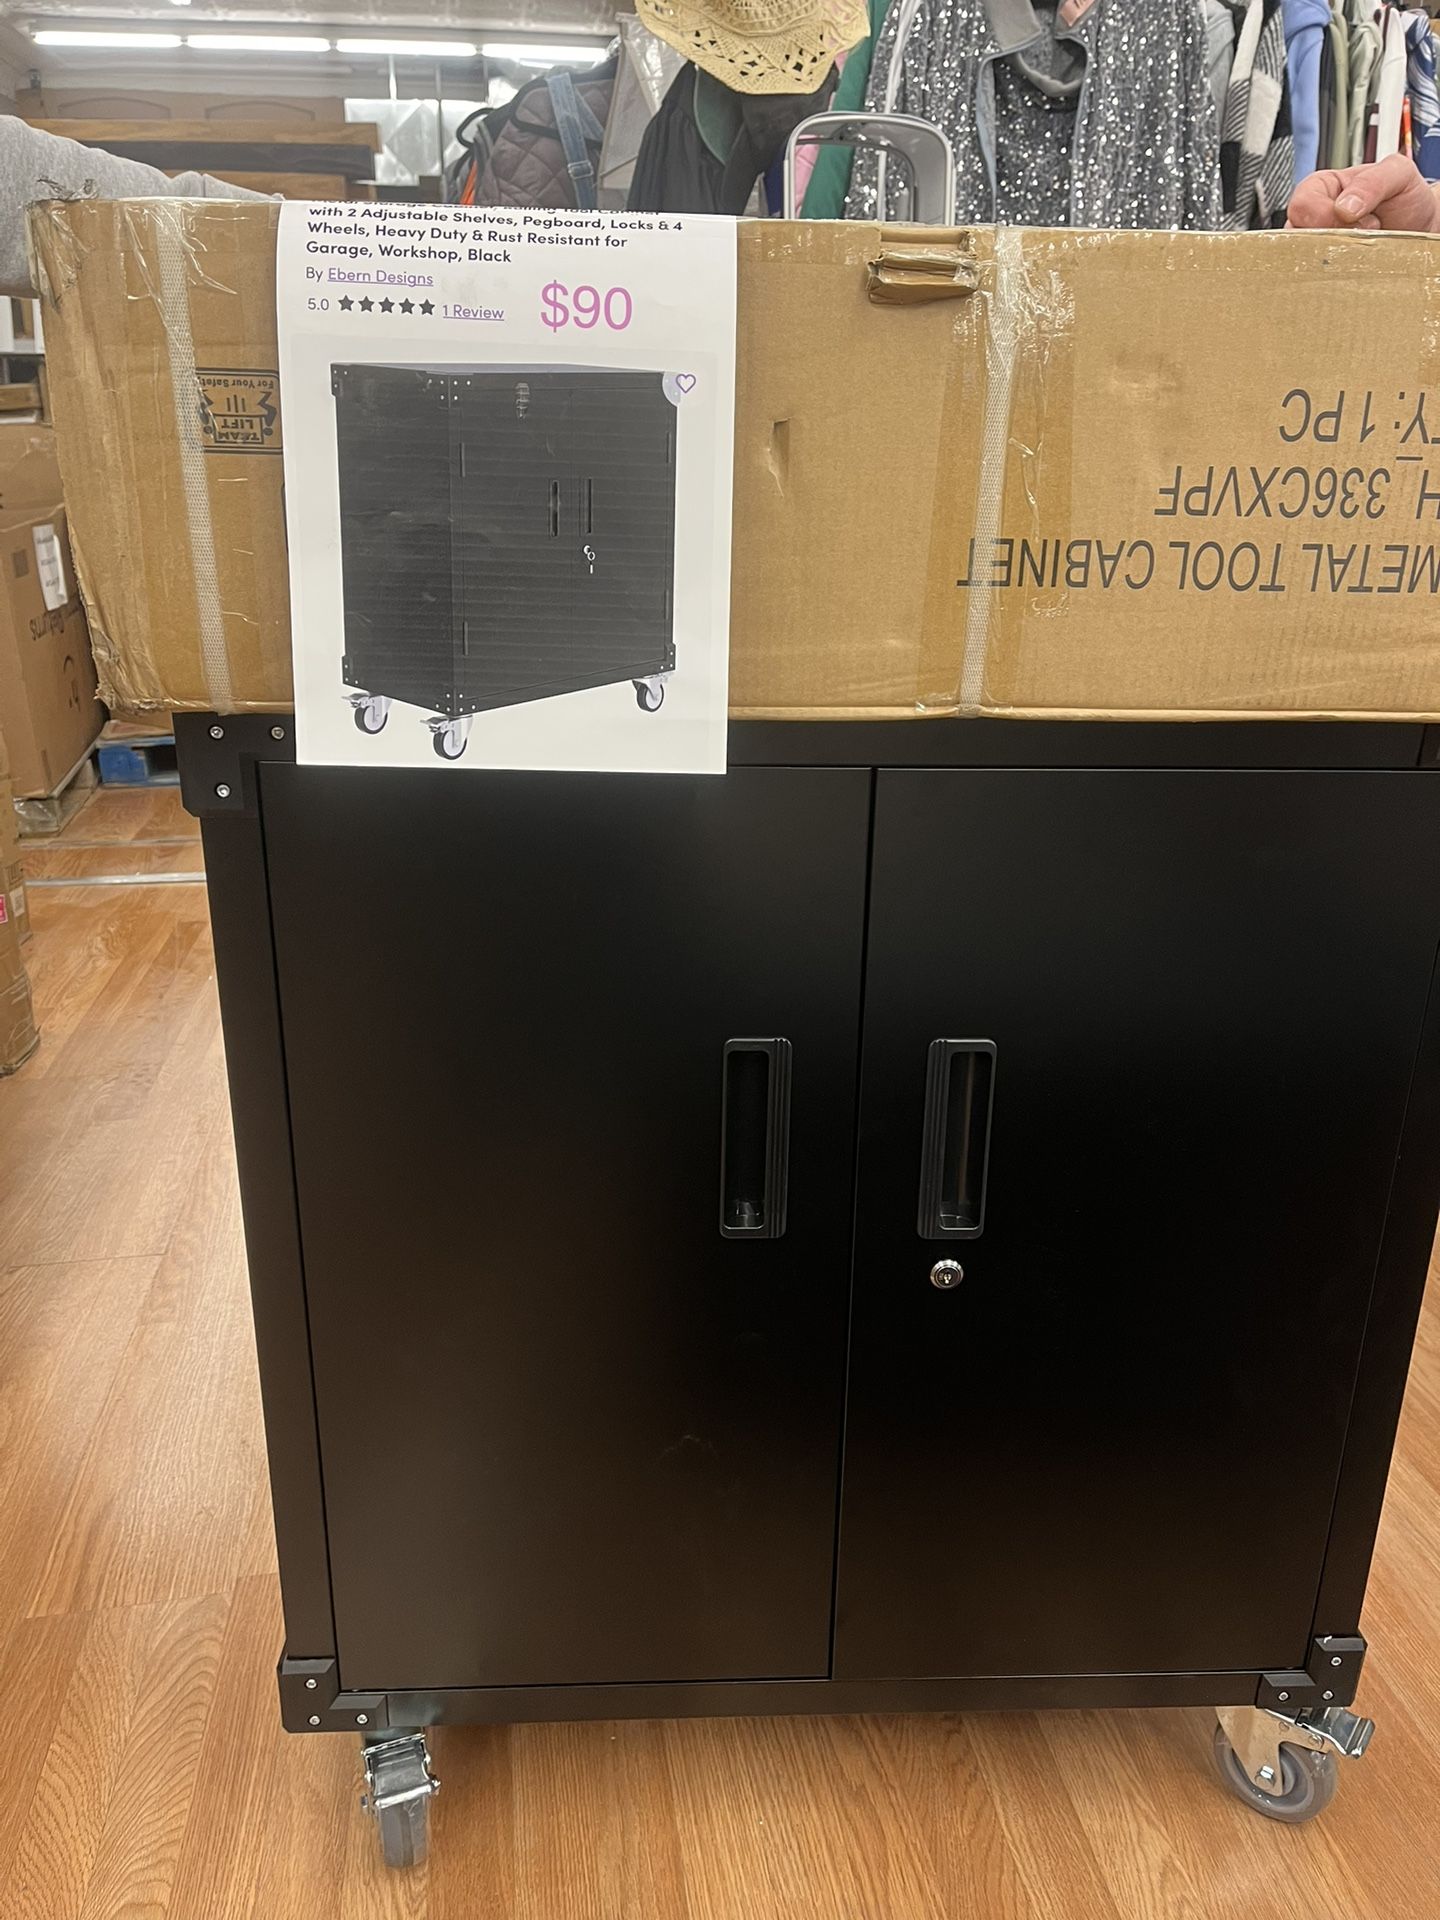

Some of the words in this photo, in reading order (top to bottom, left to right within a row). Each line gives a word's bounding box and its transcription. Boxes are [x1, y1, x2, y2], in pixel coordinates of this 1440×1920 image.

[309, 207, 343, 217] with
[347, 208, 357, 217] 2
[360, 208, 448, 222] Adjustable
[452, 212, 519, 227] Shelves,
[522, 216, 606, 231] Pegboard,
[610, 219, 654, 230] Locks
[658, 221, 669, 231] &
[672, 221, 683, 231] 4
[307, 222, 370, 237] Wheels,
[375, 225, 427, 241] Heavy
[430, 228, 468, 243] Duty
[472, 229, 483, 241] &
[487, 230, 522, 243] Rust
[527, 232, 600, 247] Resistant
[605, 235, 628, 248] for
[306, 241, 374, 258] Garage,
[378, 244, 462, 263] Workshop,
[467, 248, 512, 263] Black
[306, 266, 323, 283] By
[328, 267, 371, 283] Ebern
[376, 270, 434, 287] Designs
[307, 298, 329, 311] 5.0
[443, 304, 450, 318] 1
[453, 305, 504, 320] Review
[540, 280, 633, 333] $90
[231, 379, 255, 389] Your
[257, 380, 274, 390] For
[221, 418, 254, 429] LIFT
[1278, 388, 1346, 443] PC
[1359, 390, 1376, 444] 1
[218, 431, 260, 441] TEAM
[956, 537, 1155, 590] CABINET
[1168, 541, 1286, 593] TOOL
[1302, 543, 1440, 594] METAL
